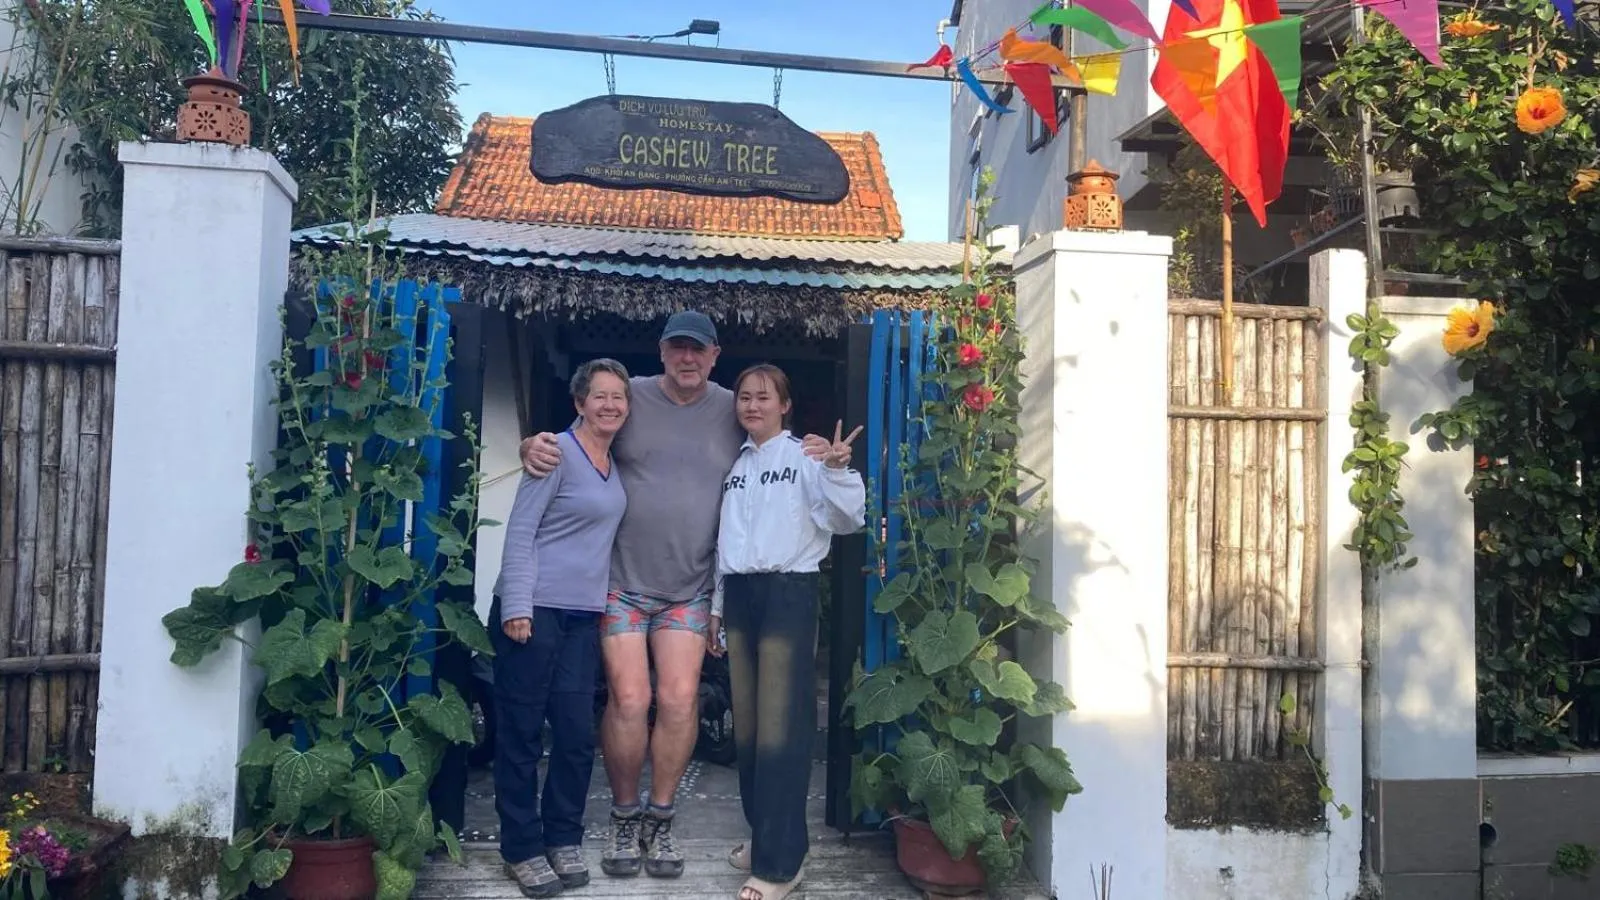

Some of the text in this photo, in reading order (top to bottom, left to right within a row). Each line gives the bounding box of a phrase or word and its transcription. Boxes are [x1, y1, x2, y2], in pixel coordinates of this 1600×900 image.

[659, 118, 733, 133] HOMESTAY
[619, 134, 779, 175] CASHEW TREE
